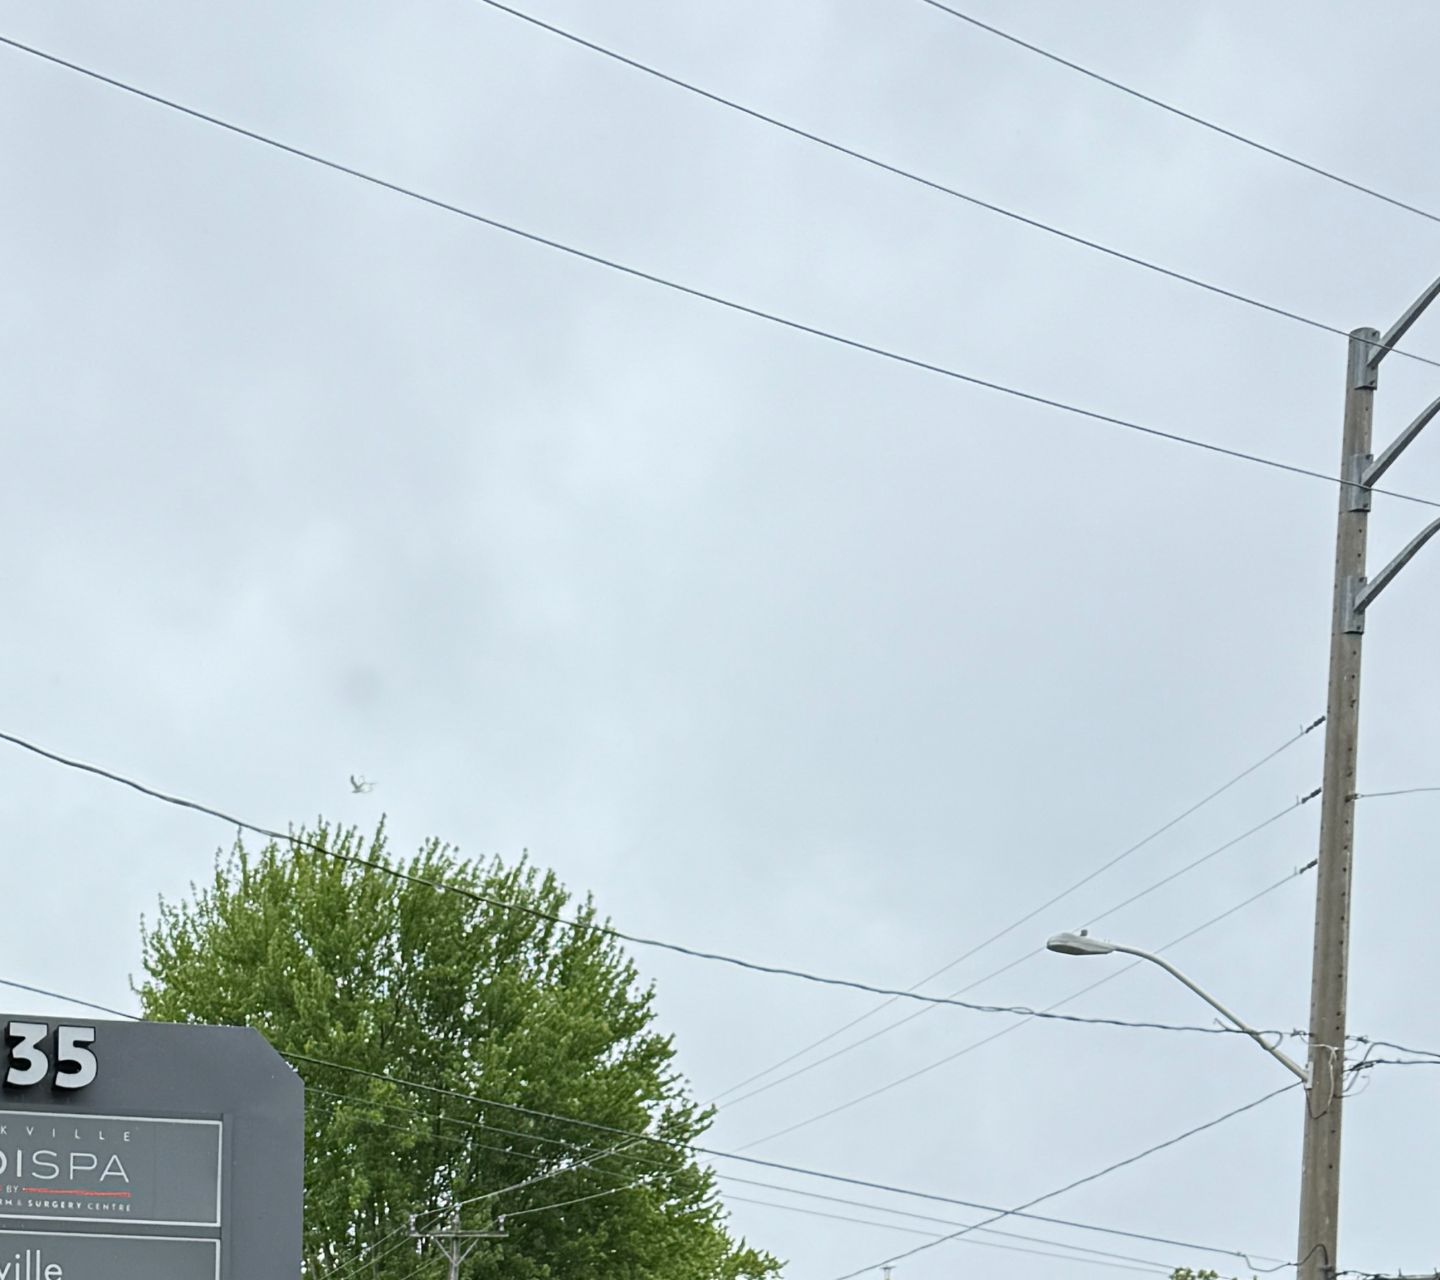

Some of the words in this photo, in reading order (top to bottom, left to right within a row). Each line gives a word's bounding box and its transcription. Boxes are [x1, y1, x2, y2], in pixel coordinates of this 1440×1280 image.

[4, 1184, 20, 1194] BY
[27, 1199, 82, 1209] SURGERY
[87, 1202, 131, 1212] CENTRE
